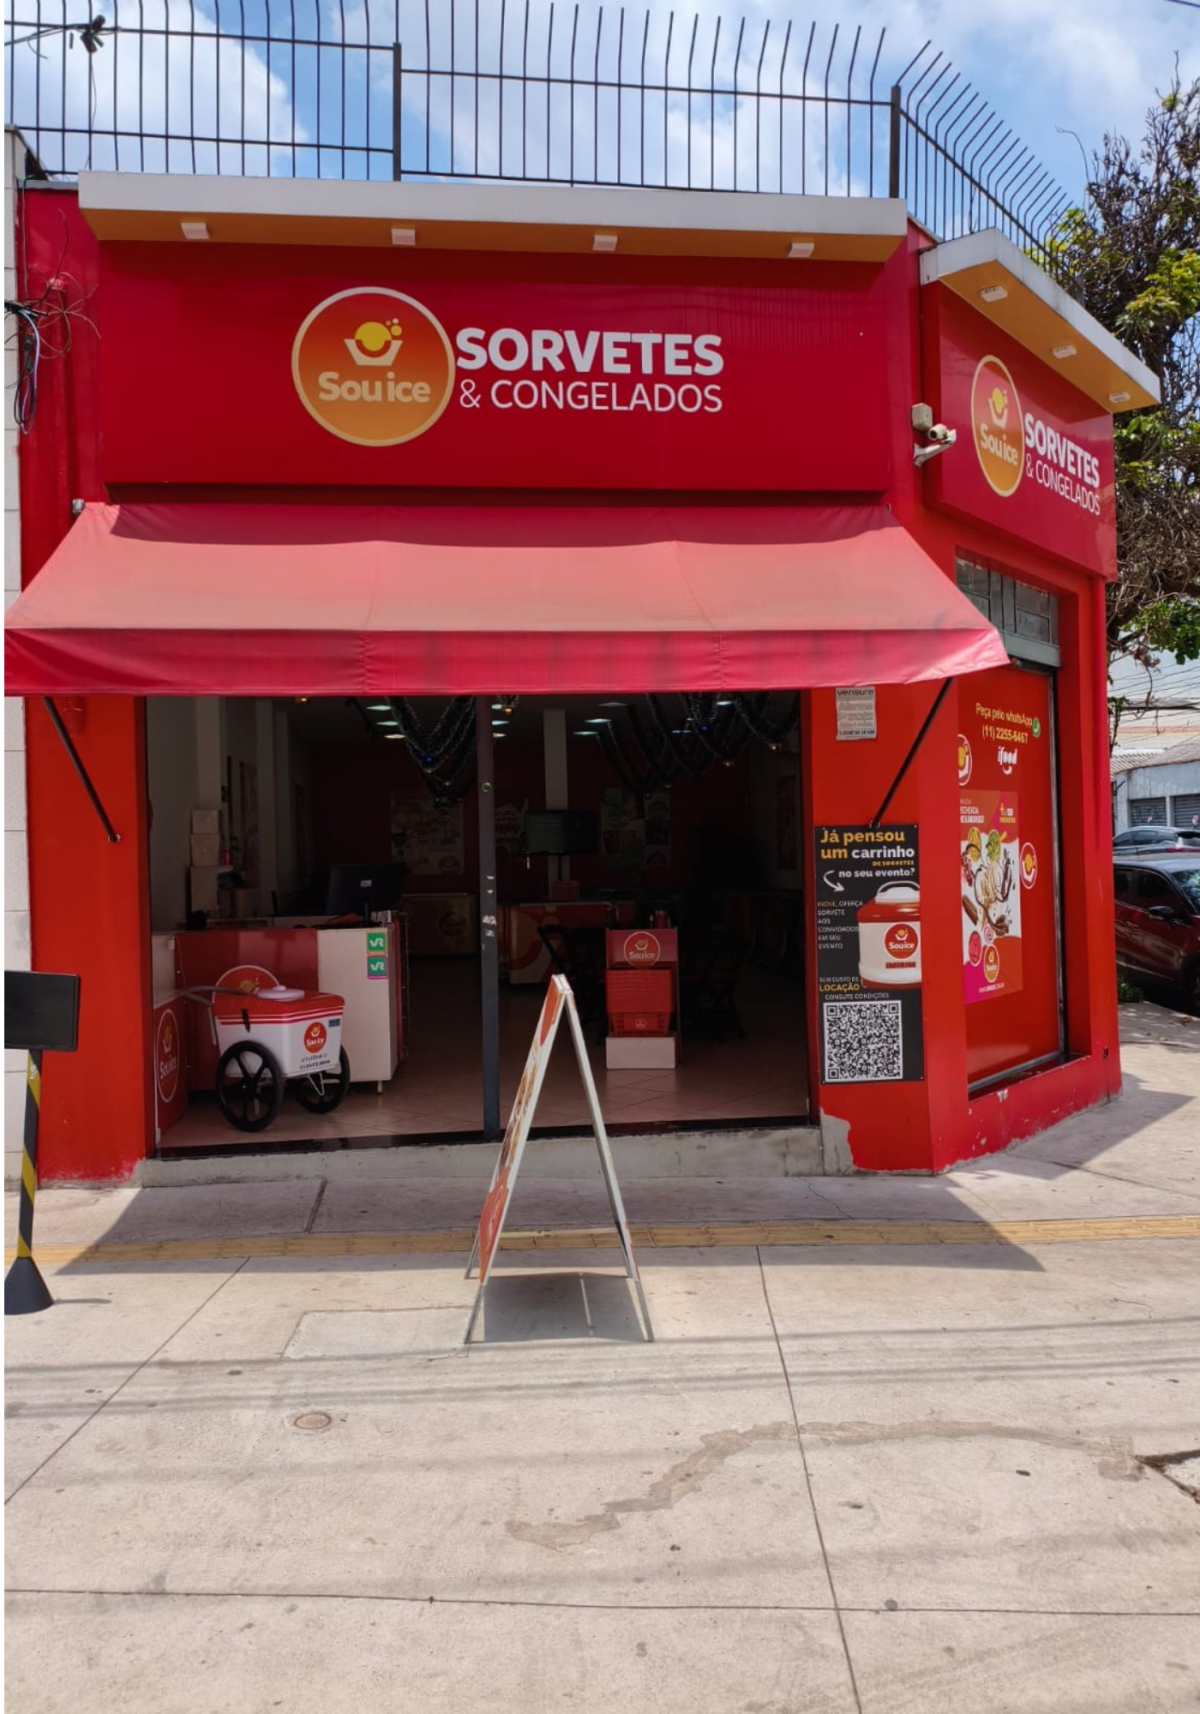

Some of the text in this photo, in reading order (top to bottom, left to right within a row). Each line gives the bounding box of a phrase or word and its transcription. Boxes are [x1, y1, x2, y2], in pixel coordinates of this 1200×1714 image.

[456, 327, 724, 376] SORVETES
[459, 379, 723, 413] & CONGELADOS
[1025, 412, 1100, 488] SORVETES
[1025, 453, 1100, 516] & CONGELADOS
[975, 702, 991, 719] Peça
[992, 708, 1005, 721] pelo
[982, 724, 995, 741] (11)
[821, 829, 905, 846] Já pensou
[821, 845, 915, 858] um carrinho
[838, 870, 852, 878] no
[875, 867, 915, 876] evento?
[819, 982, 860, 992] LOCAÇÃO
